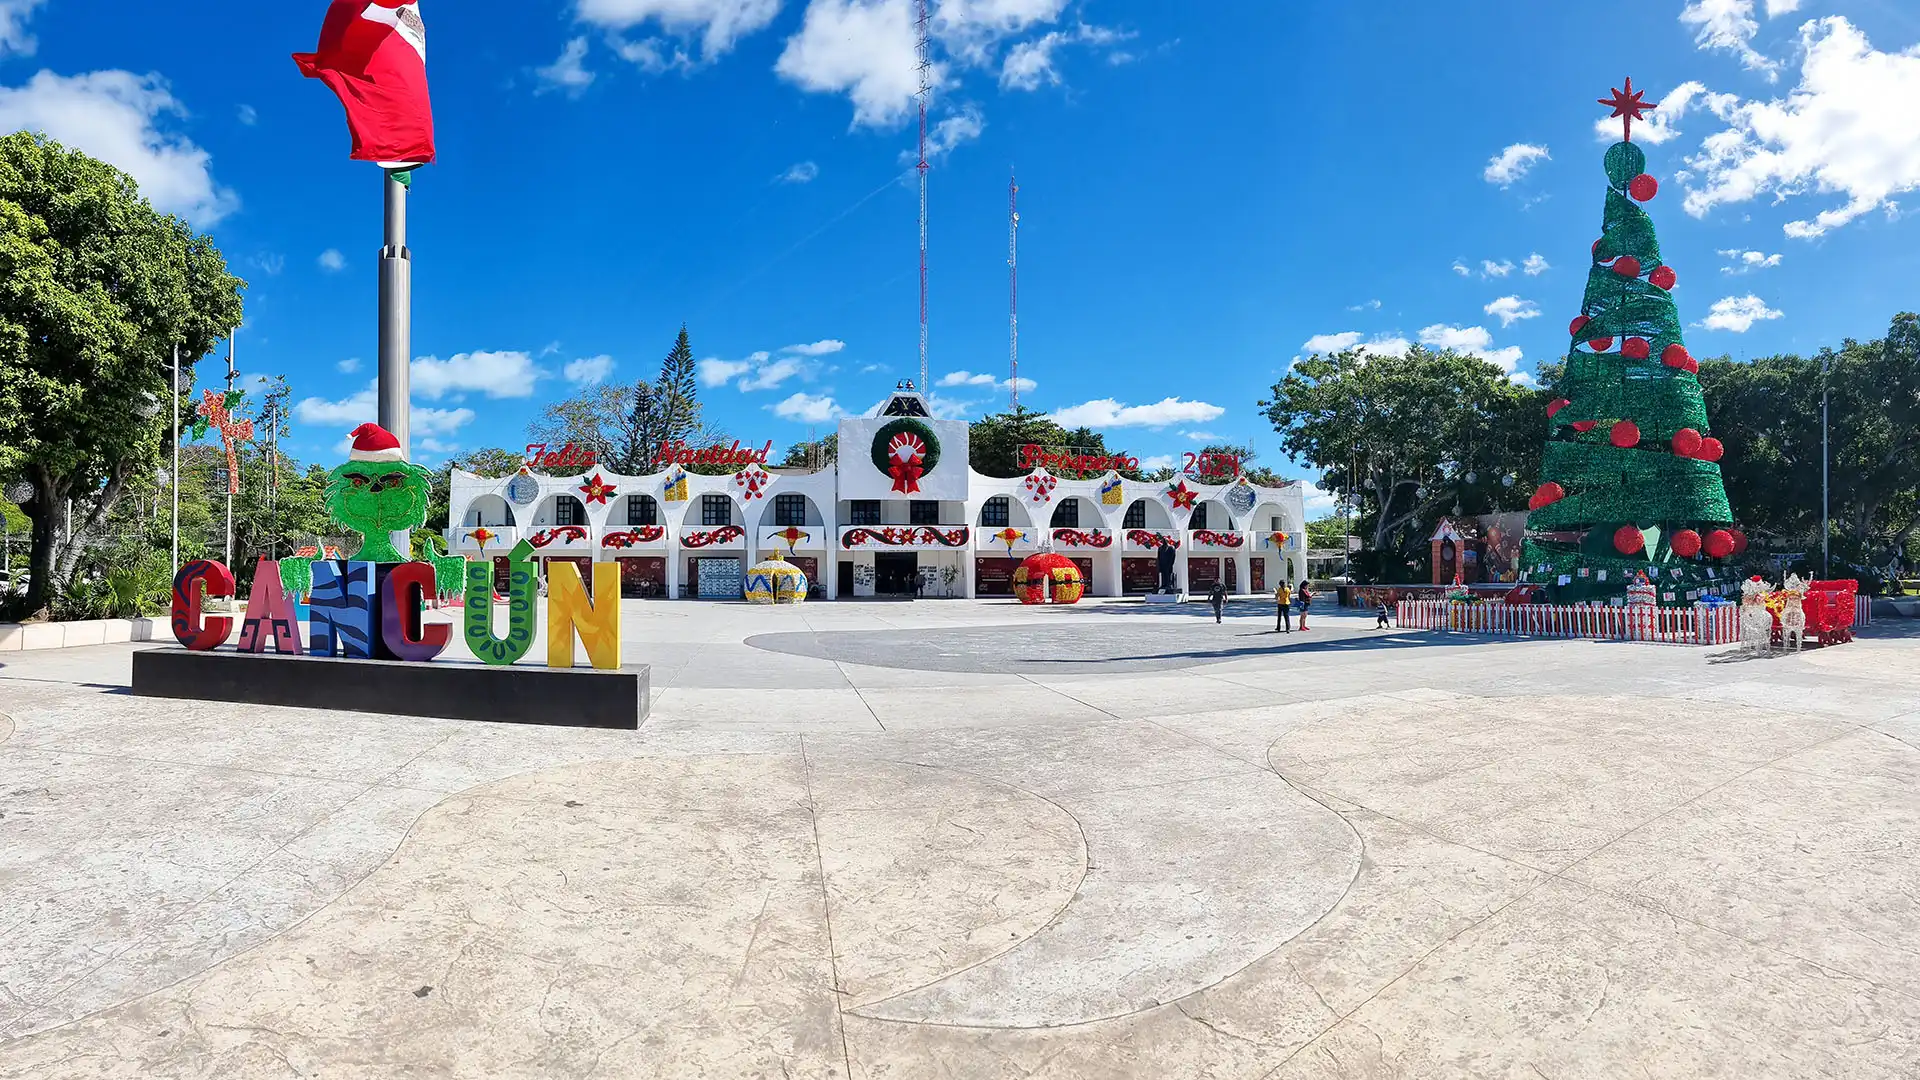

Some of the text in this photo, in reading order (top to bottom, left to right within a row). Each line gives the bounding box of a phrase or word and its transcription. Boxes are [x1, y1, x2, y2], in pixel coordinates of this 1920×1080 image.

[527, 440, 772, 466] Feliz Navidad
[1184, 452, 1239, 477] 2024
[171, 537, 621, 669] CANCÚN
